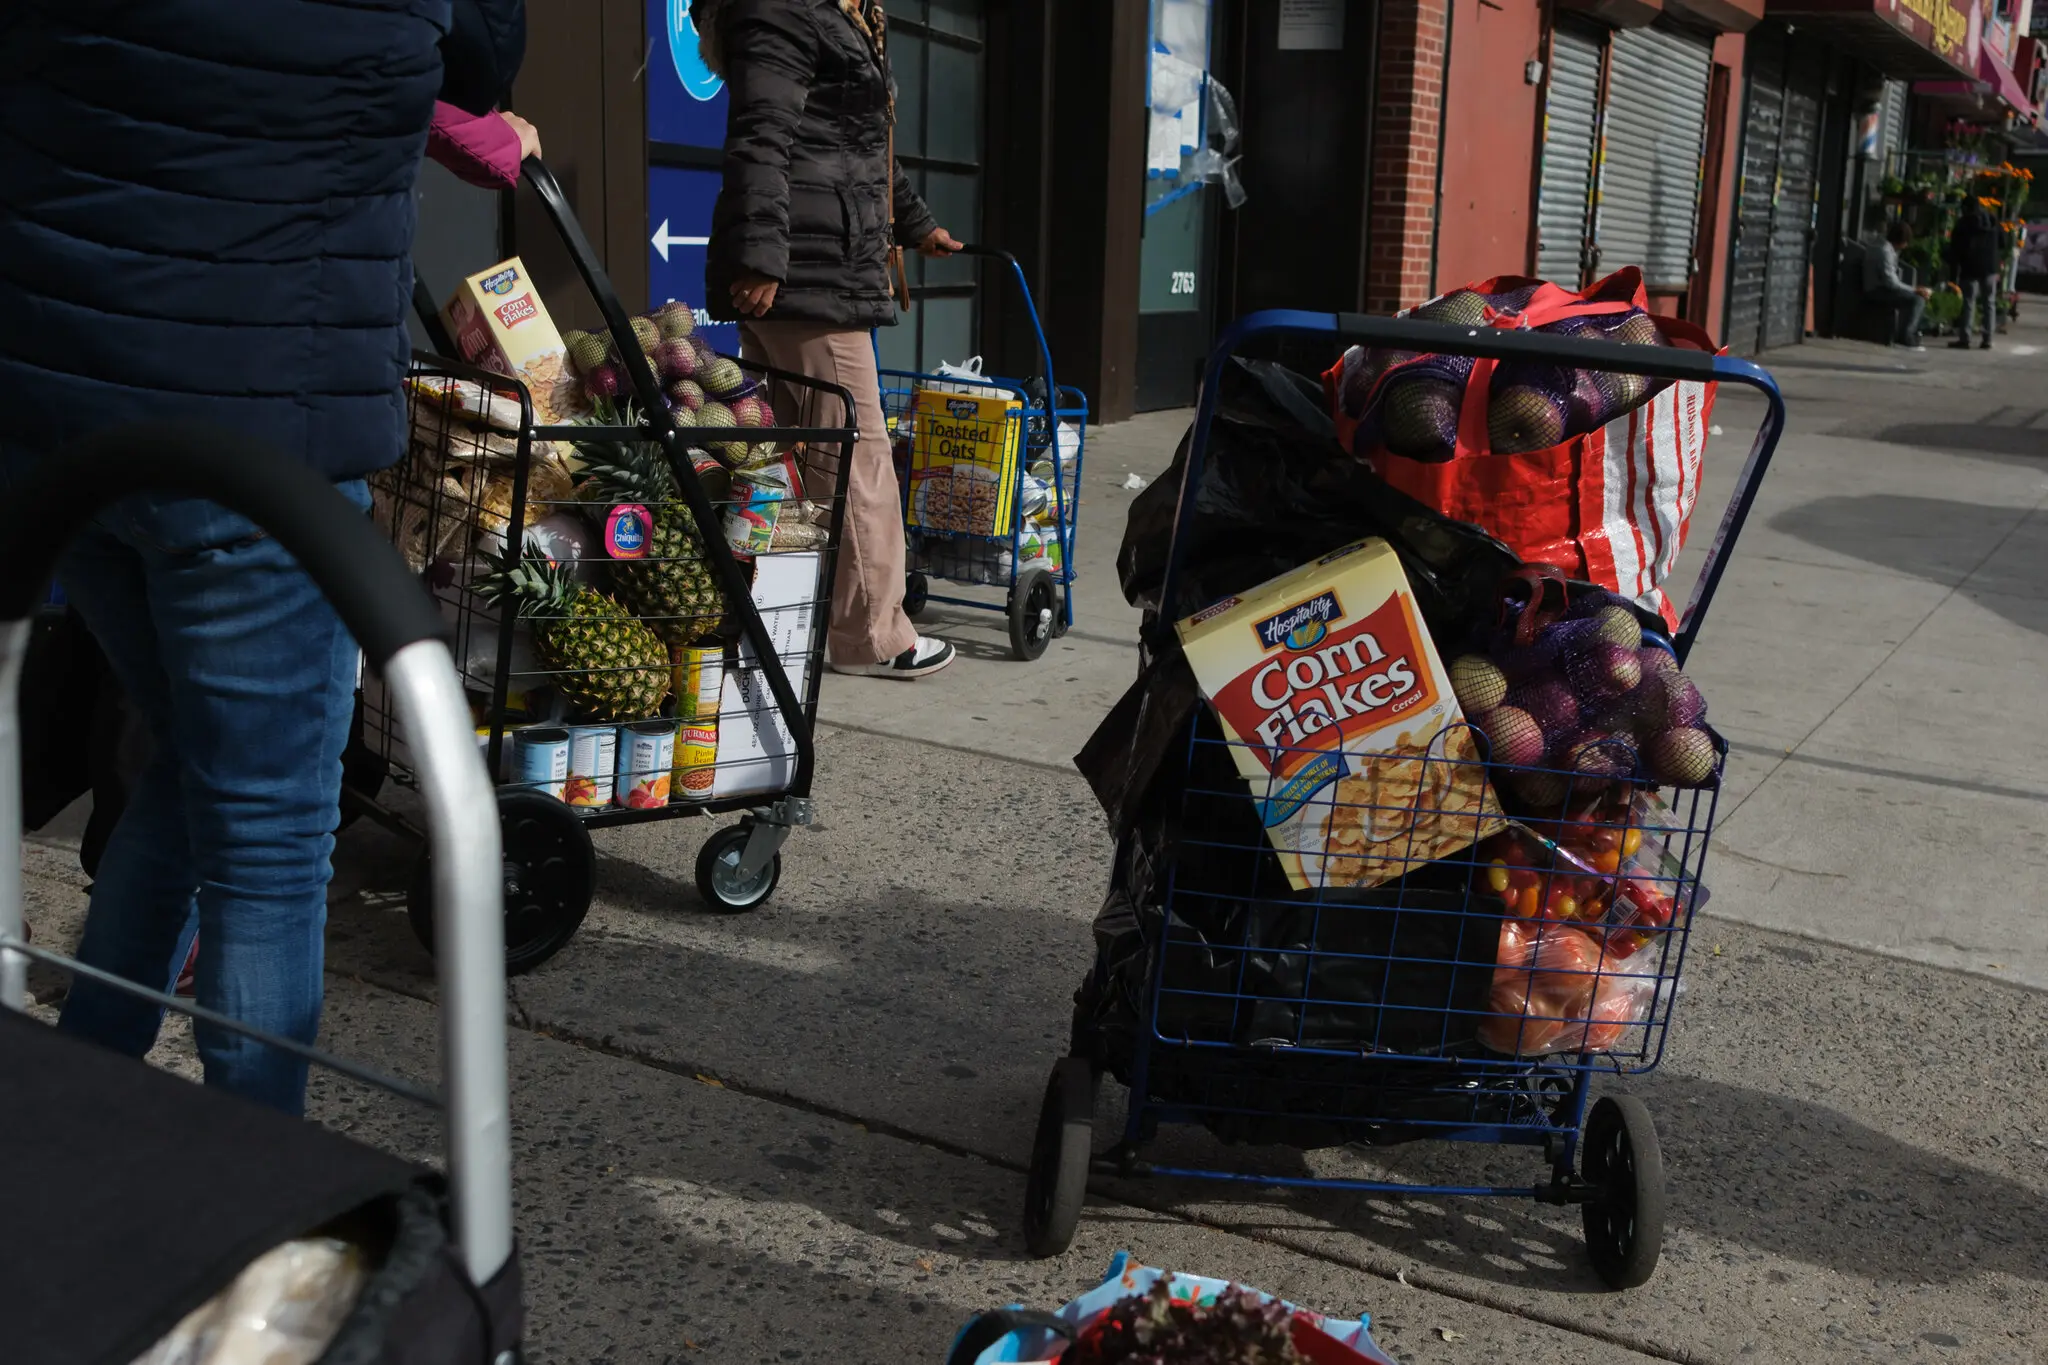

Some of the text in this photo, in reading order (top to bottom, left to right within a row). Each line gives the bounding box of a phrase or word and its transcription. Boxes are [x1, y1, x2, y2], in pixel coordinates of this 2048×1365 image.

[484, 268, 515, 291] Hospitality
[1171, 271, 1196, 294] 2763
[500, 299, 528, 315] Corn
[503, 304, 535, 327] Flakes
[928, 419, 989, 442] Toasted
[940, 439, 976, 460] Oats
[614, 533, 644, 544] Chiquita
[1264, 597, 1333, 643] Hospitality
[1250, 631, 1387, 710] Corn
[1254, 656, 1416, 764] Flakes
[1391, 689, 1424, 714] Cereal
[1299, 764, 1321, 784] SOURCE
[1320, 758, 1329, 768] OF
[1301, 783, 1313, 795] AND
